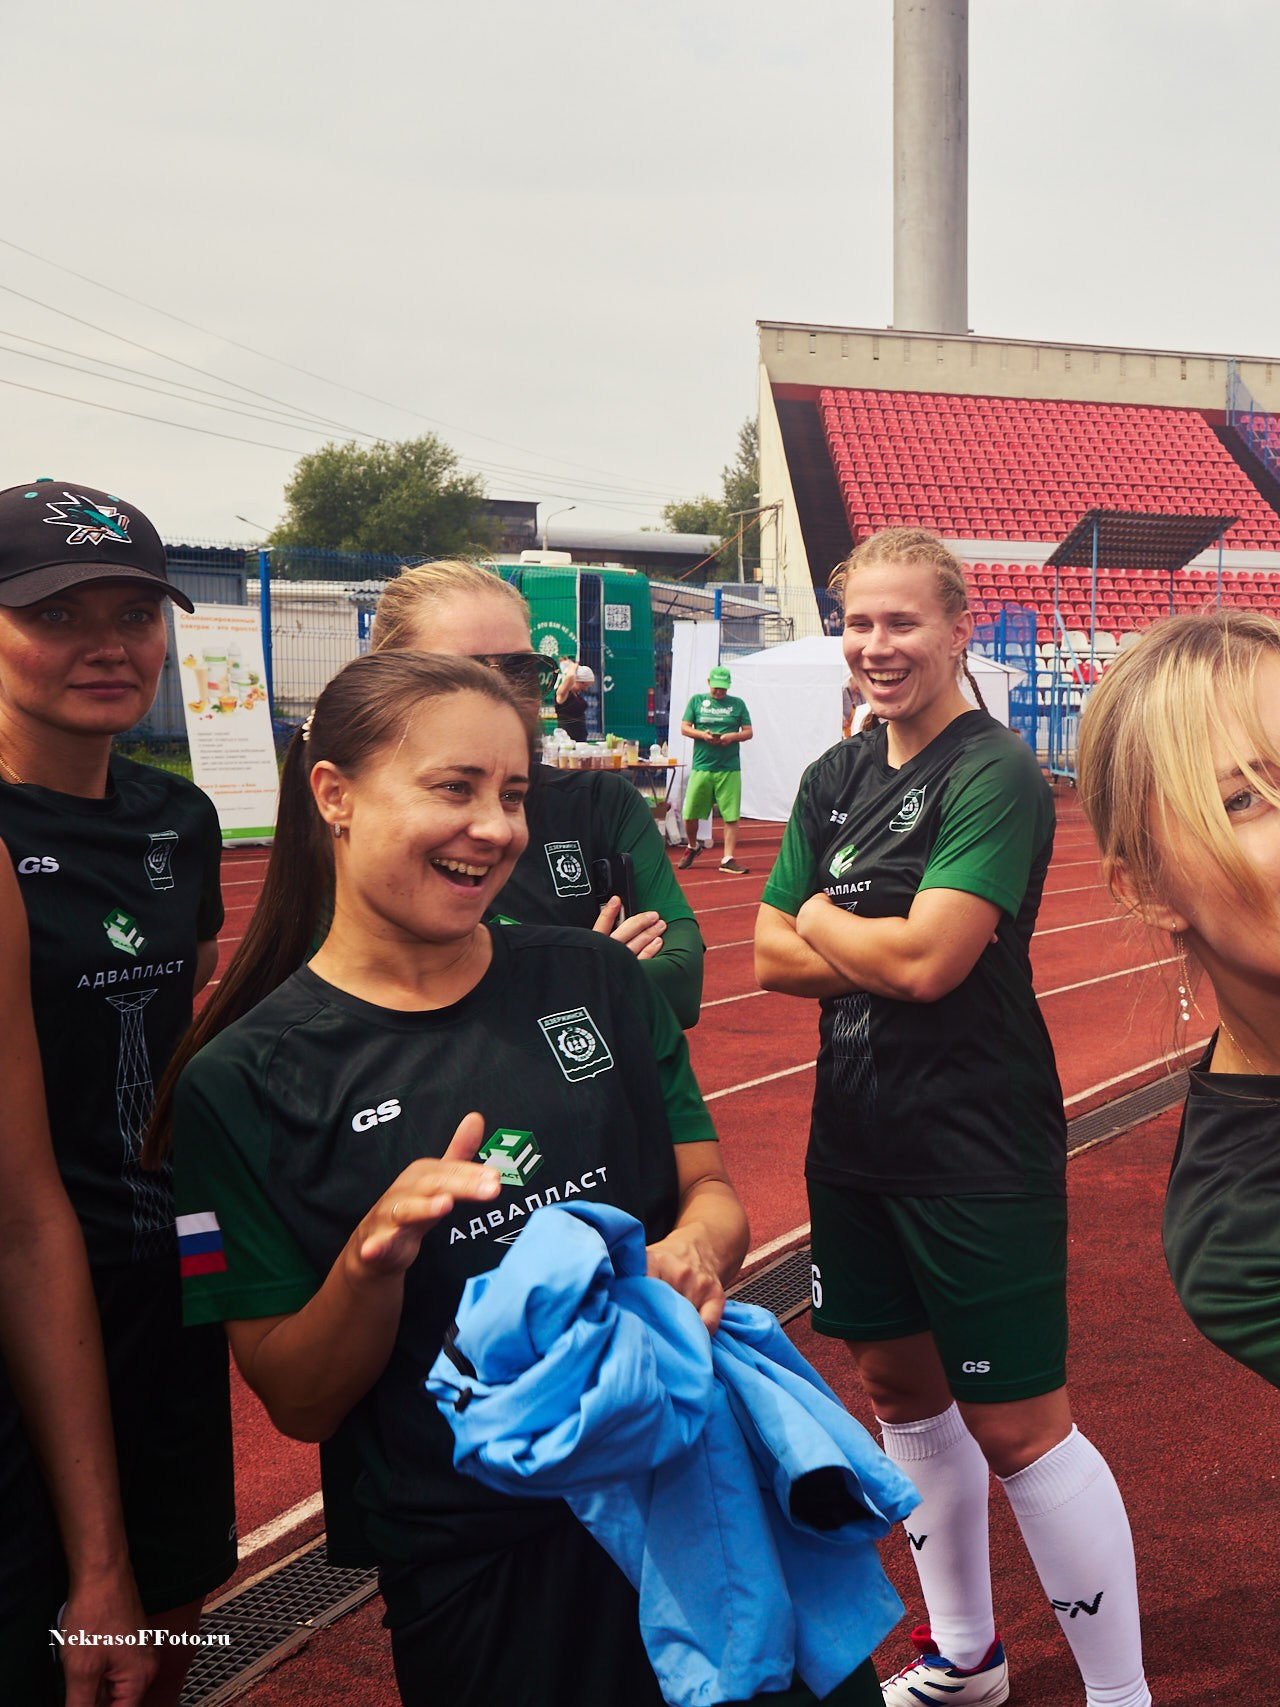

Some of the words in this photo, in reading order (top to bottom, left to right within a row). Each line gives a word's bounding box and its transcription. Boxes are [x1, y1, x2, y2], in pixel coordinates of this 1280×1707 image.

[17, 856, 60, 875] GS
[77, 959, 184, 989] АДВАПЛАСТ
[351, 1098, 402, 1132] GS
[450, 1166, 608, 1245] АДВАПЛАСТ
[962, 1361, 991, 1374] GS
